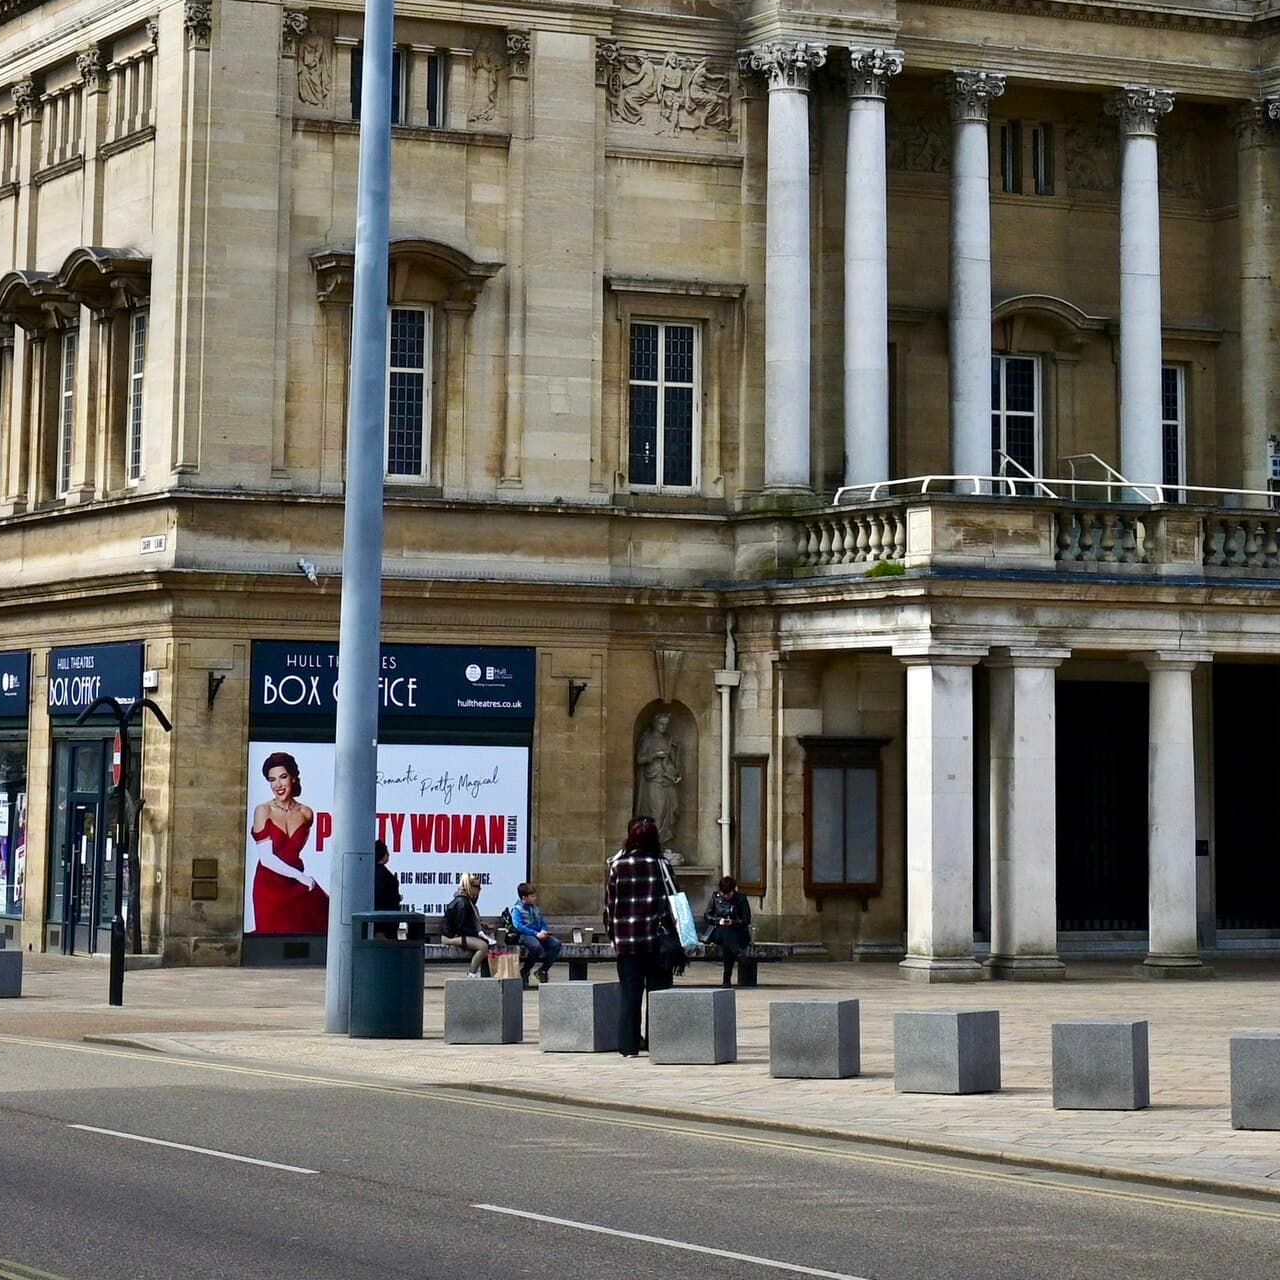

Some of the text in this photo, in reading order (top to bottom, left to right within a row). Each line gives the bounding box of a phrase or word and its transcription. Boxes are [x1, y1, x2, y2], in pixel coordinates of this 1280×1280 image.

[57, 656, 95, 670] HULL THEATRES
[287, 654, 322, 668] HULL
[49, 676, 69, 707] BOX
[71, 675, 101, 706] OFFICE
[263, 674, 321, 706] BOX
[457, 698, 523, 709] hulltheatres.co.uk
[419, 771, 455, 805] Pretty
[457, 766, 500, 799] Magical
[315, 811, 506, 854] PTY WOMAN
[507, 815, 518, 854] THE MUSICAL
[400, 871, 414, 885] BIG
[415, 871, 437, 885] NIGHT
[438, 872, 454, 885] OUT.
